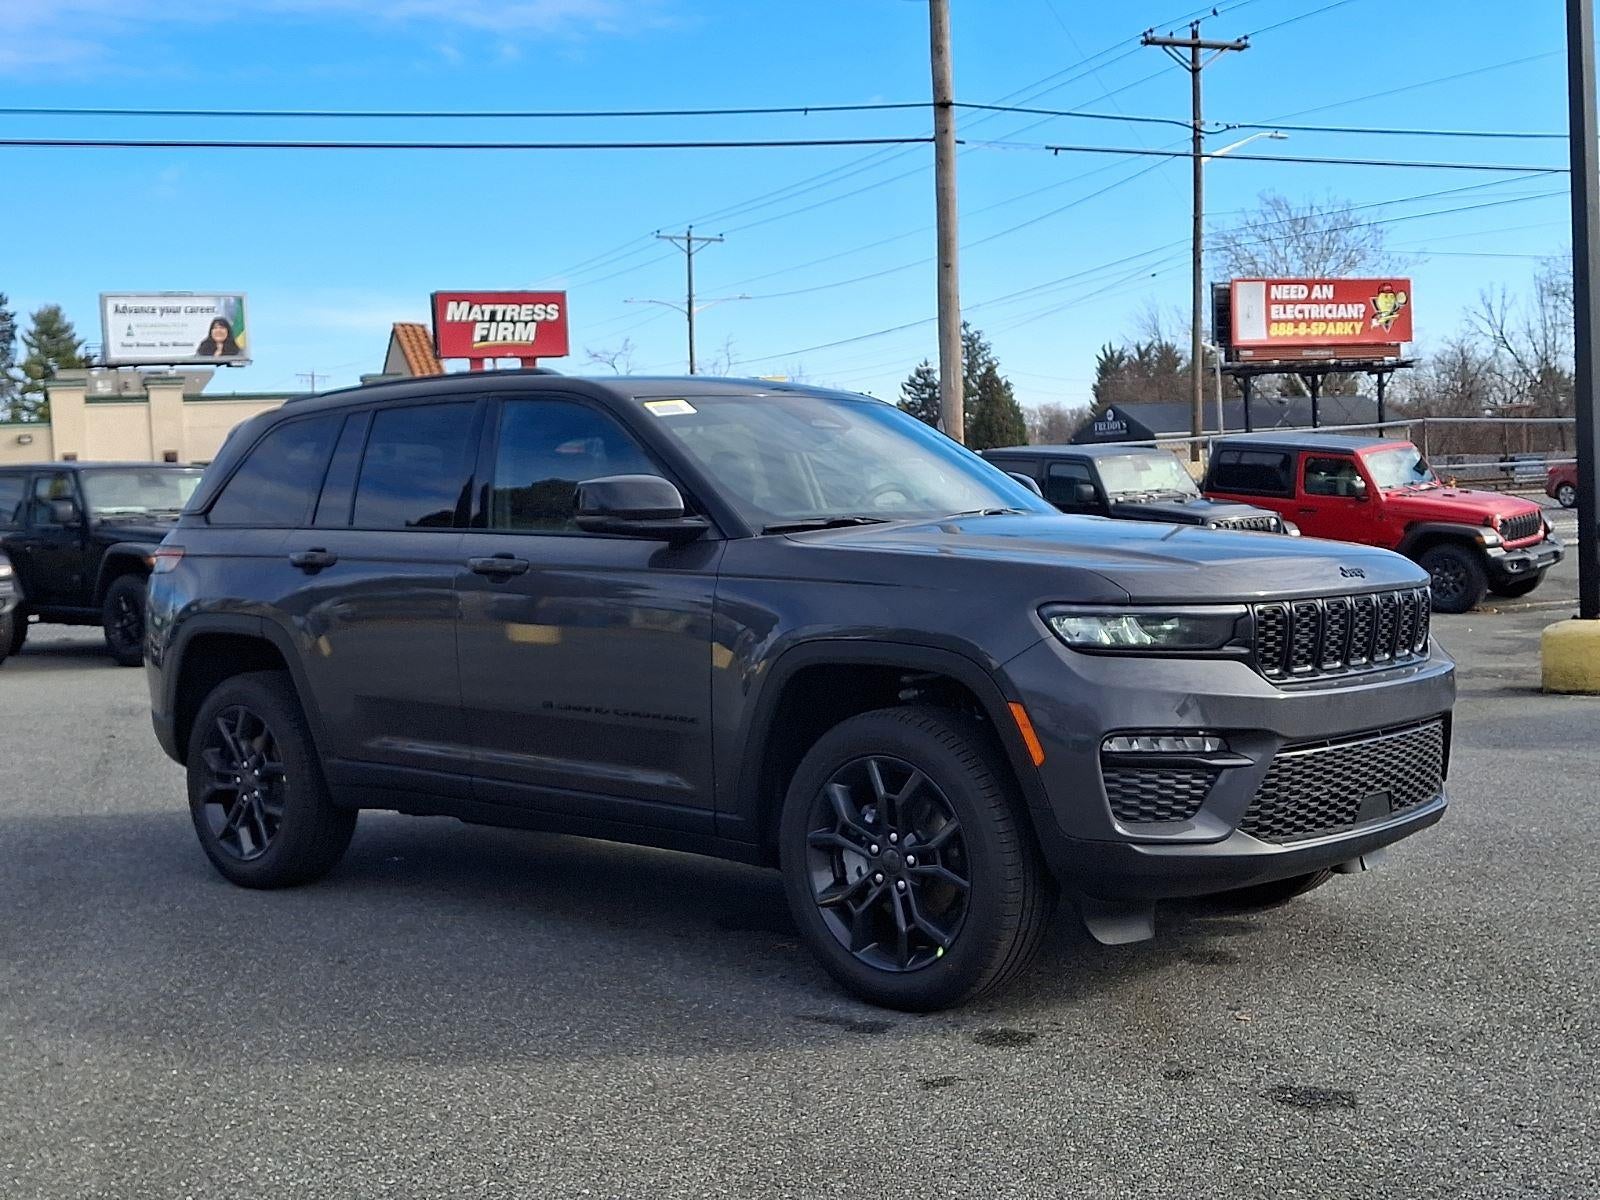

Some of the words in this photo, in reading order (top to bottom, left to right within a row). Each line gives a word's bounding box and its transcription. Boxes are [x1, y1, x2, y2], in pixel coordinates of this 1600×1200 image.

[1271, 285, 1308, 299] NEED
[1311, 285, 1334, 299] AN
[114, 304, 157, 314] Advance
[159, 305, 182, 318] your
[1270, 303, 1366, 319] ELECTRICIAN?
[473, 322, 537, 342] FIRM
